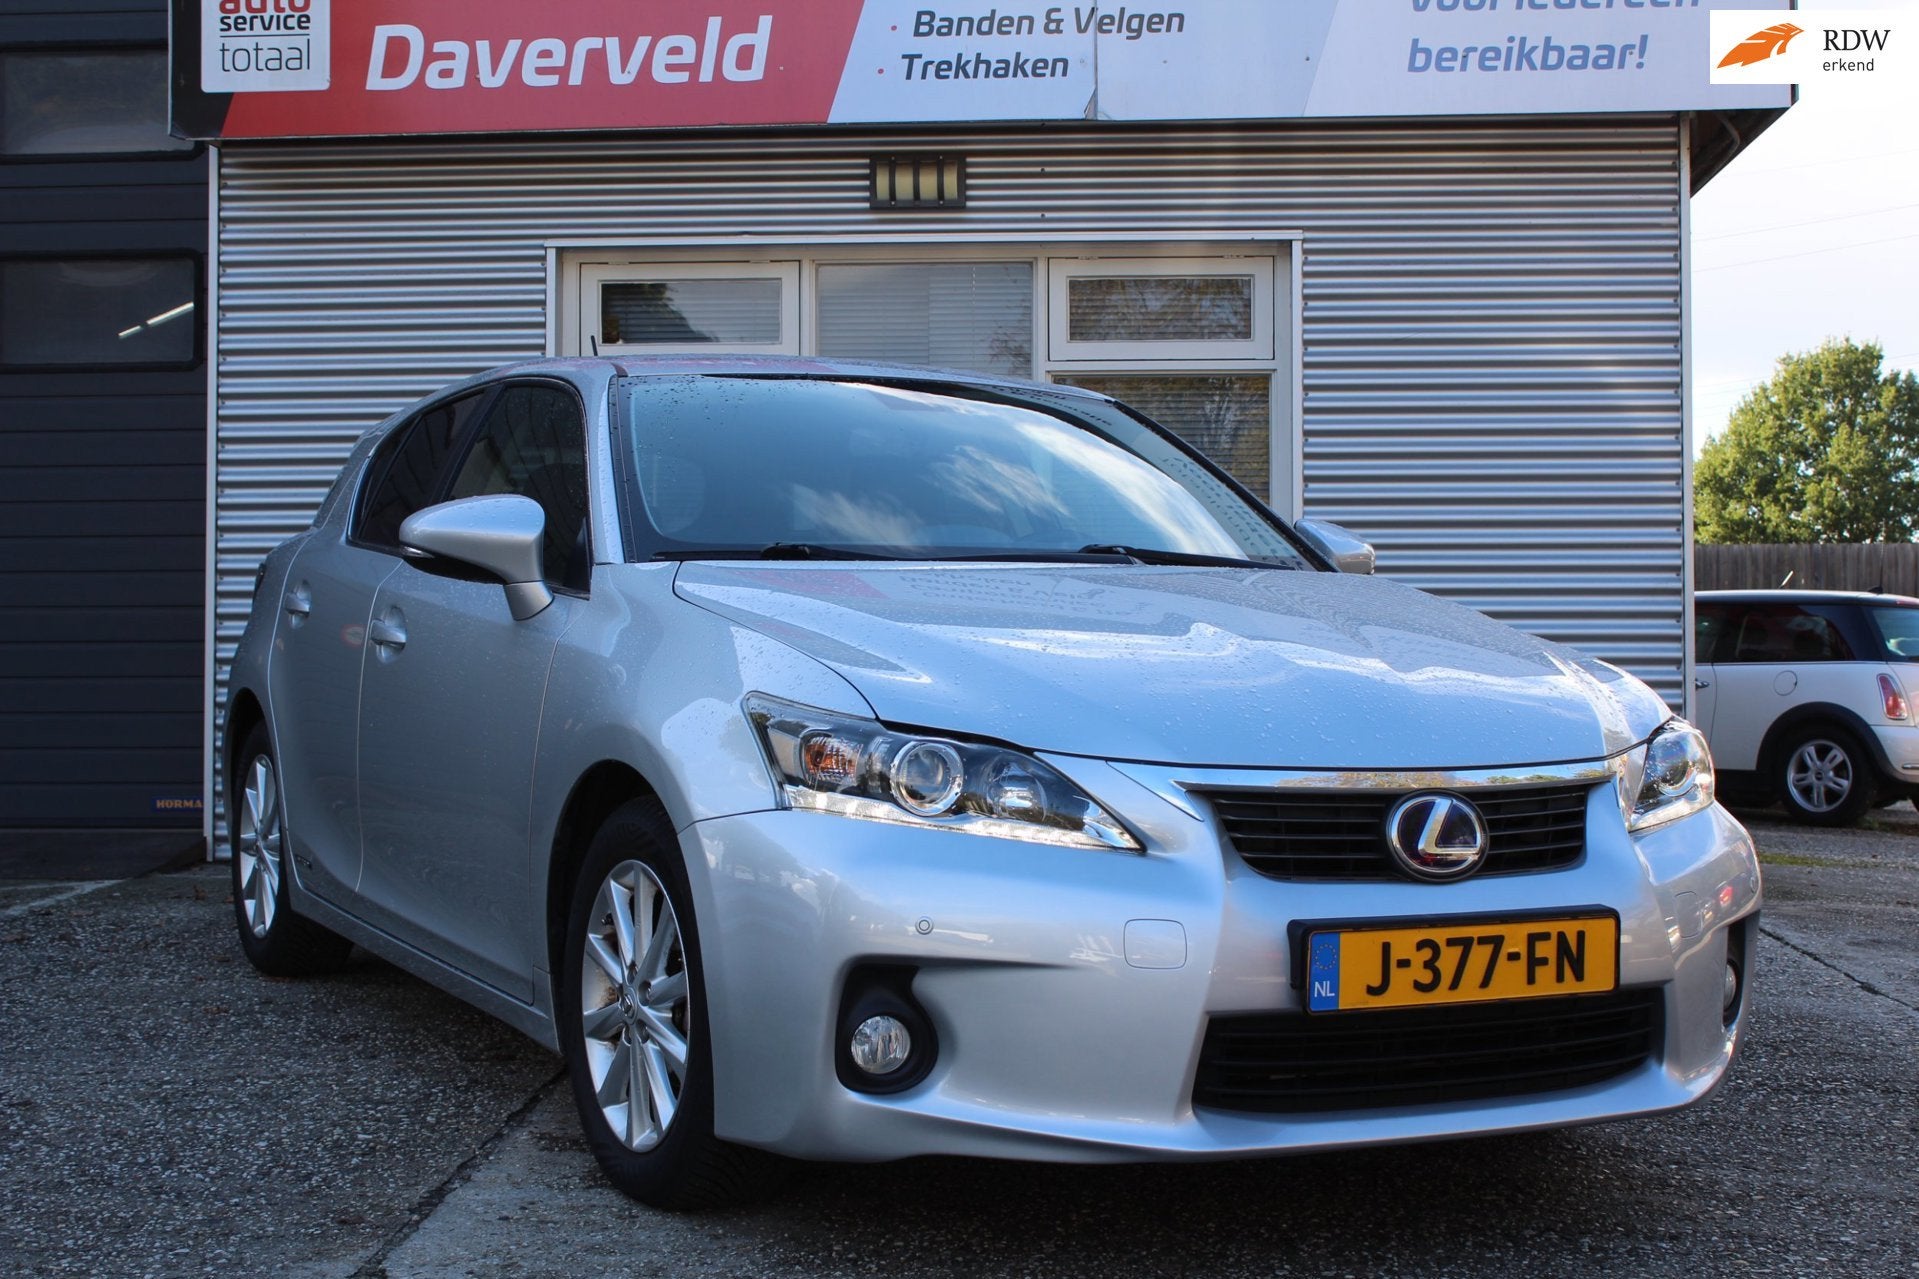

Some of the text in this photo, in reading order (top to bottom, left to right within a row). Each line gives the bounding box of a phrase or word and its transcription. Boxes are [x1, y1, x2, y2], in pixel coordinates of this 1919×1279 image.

[219, 14, 311, 32] service
[913, 6, 1185, 40] Banden & Velgen
[219, 38, 310, 72] totaal
[366, 15, 773, 91] Daverveld
[901, 52, 1069, 80] Trekhaken
[1407, 34, 1648, 73] bereikbaar!
[1366, 930, 1585, 996] J-377-FN
[1314, 981, 1335, 998] NL
